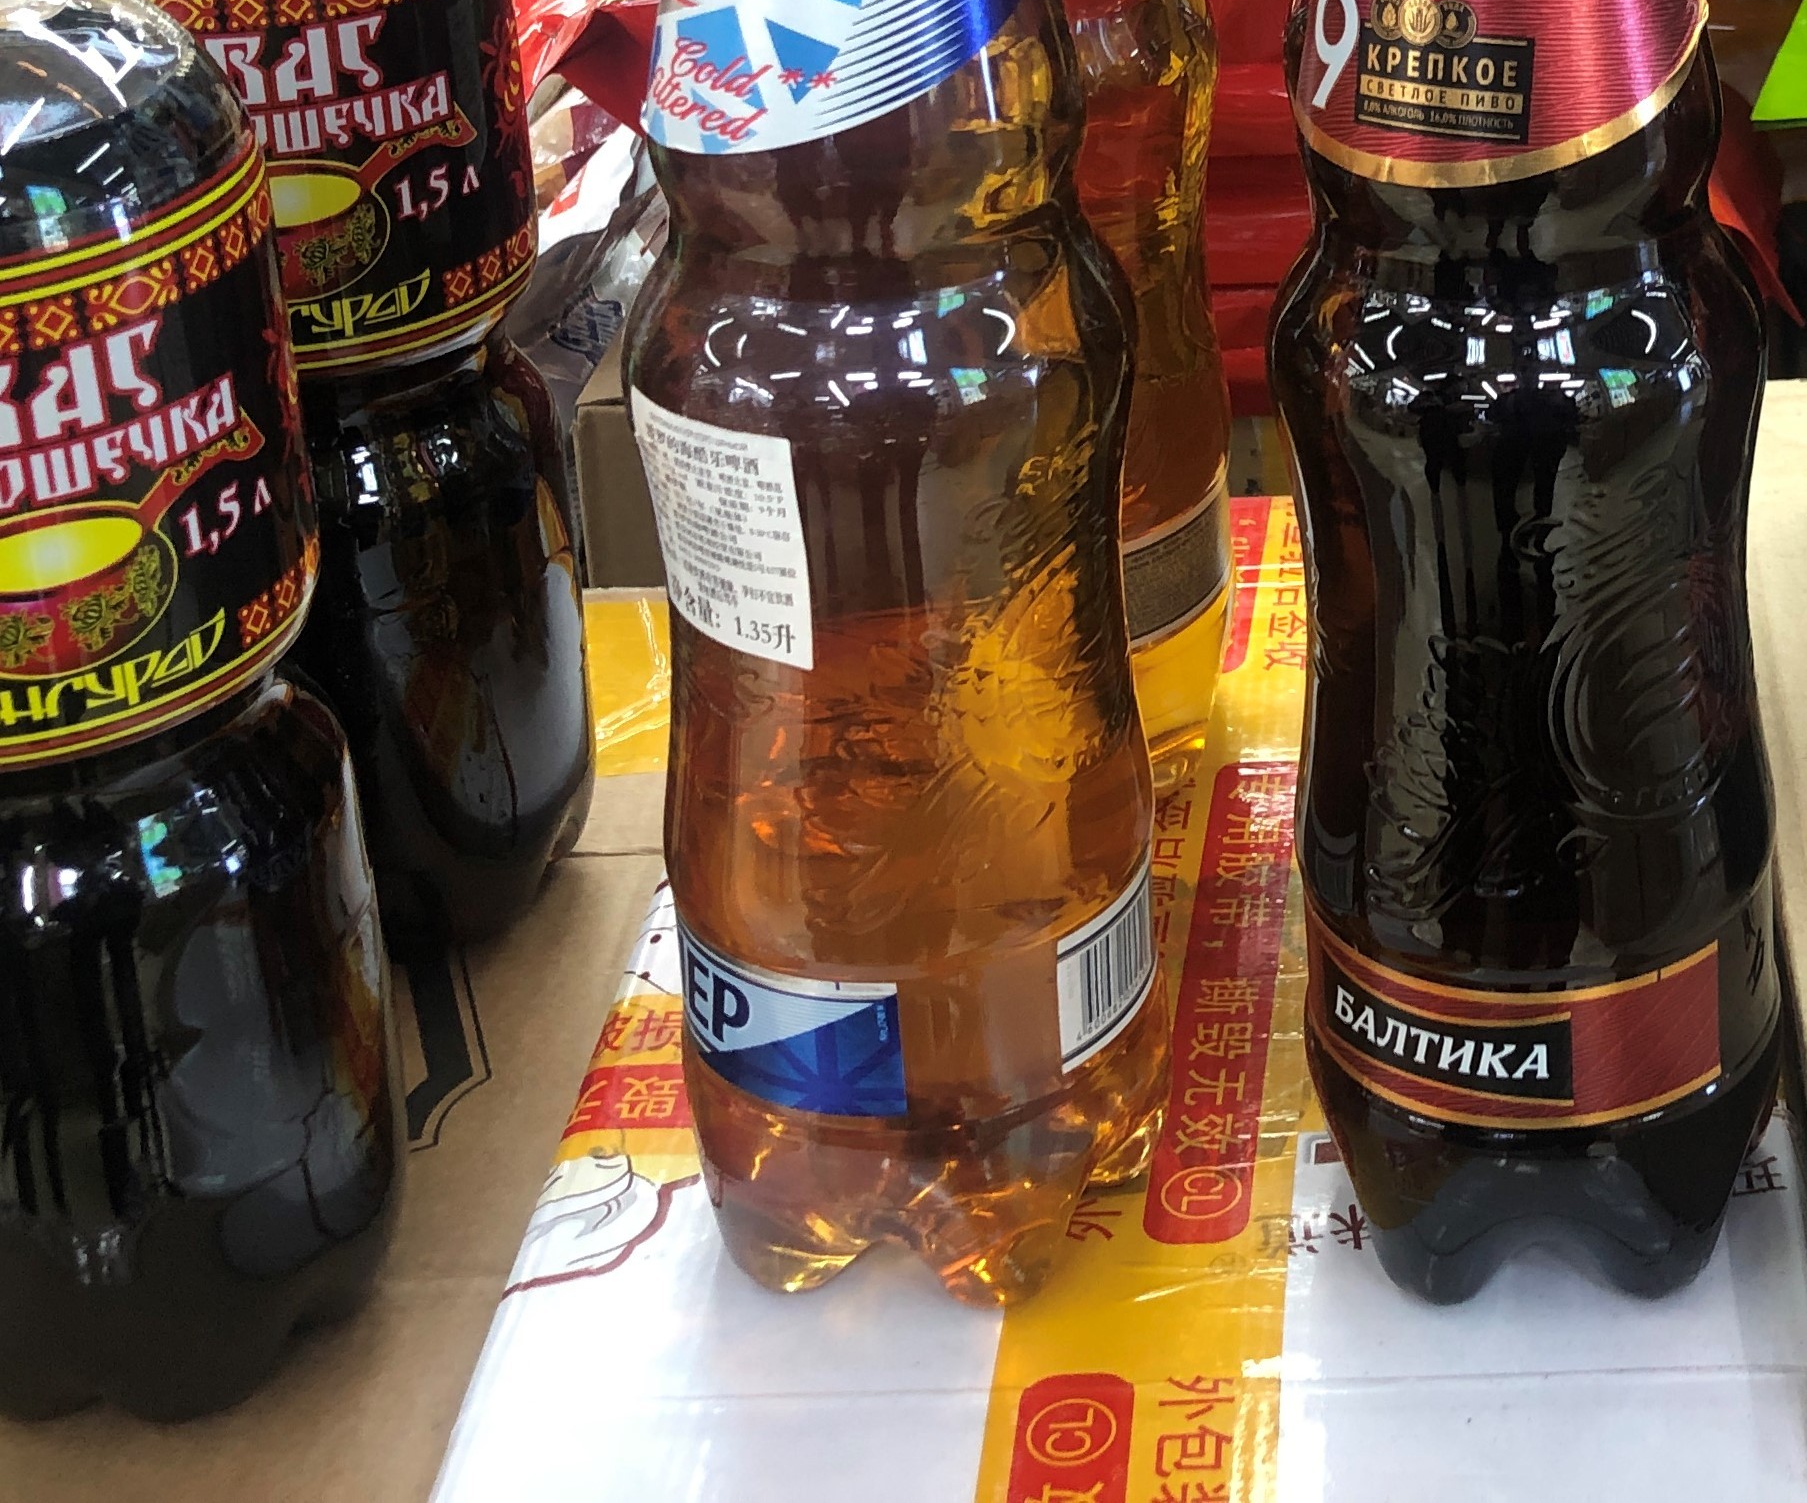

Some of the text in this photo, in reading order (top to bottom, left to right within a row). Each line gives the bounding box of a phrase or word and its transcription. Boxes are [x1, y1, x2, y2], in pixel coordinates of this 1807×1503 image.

[203, 14, 384, 106] ВАС
[671, 35, 774, 99] Cold
[1366, 42, 1519, 88] КРЕПКОЕ
[1366, 78, 1516, 111] СВЕТЛОЕ ПИВО
[733, 614, 796, 655] 1.35升
[686, 945, 751, 1044] ЕР
[1334, 983, 1551, 1082] БАЛТИКА
